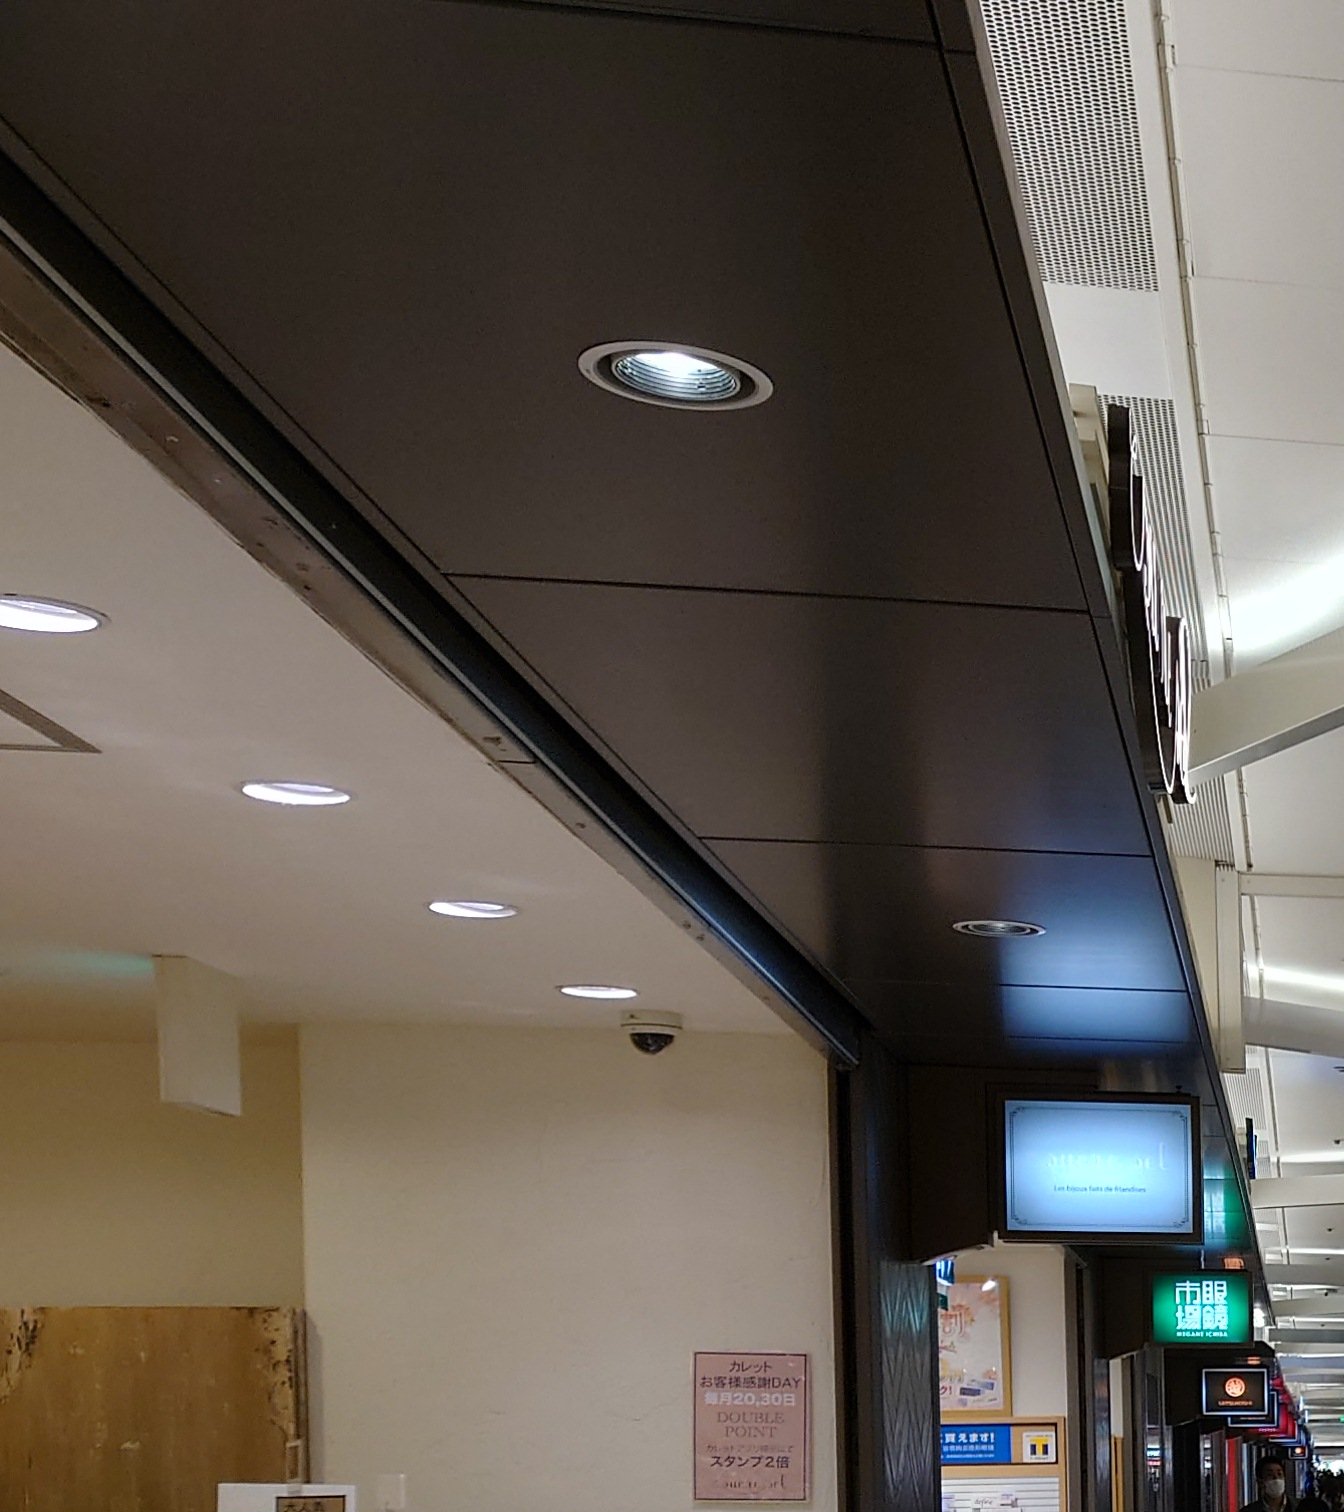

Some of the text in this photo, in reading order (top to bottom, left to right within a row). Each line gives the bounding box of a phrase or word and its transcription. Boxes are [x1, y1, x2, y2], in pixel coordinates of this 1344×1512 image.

[729, 1360, 772, 1373] カレット
[700, 1376, 801, 1389] お客様感謝DAY
[717, 1411, 785, 1424] DOUBLE
[725, 1426, 777, 1438] POINT
[710, 1456, 790, 1469] スタンプ2倍
